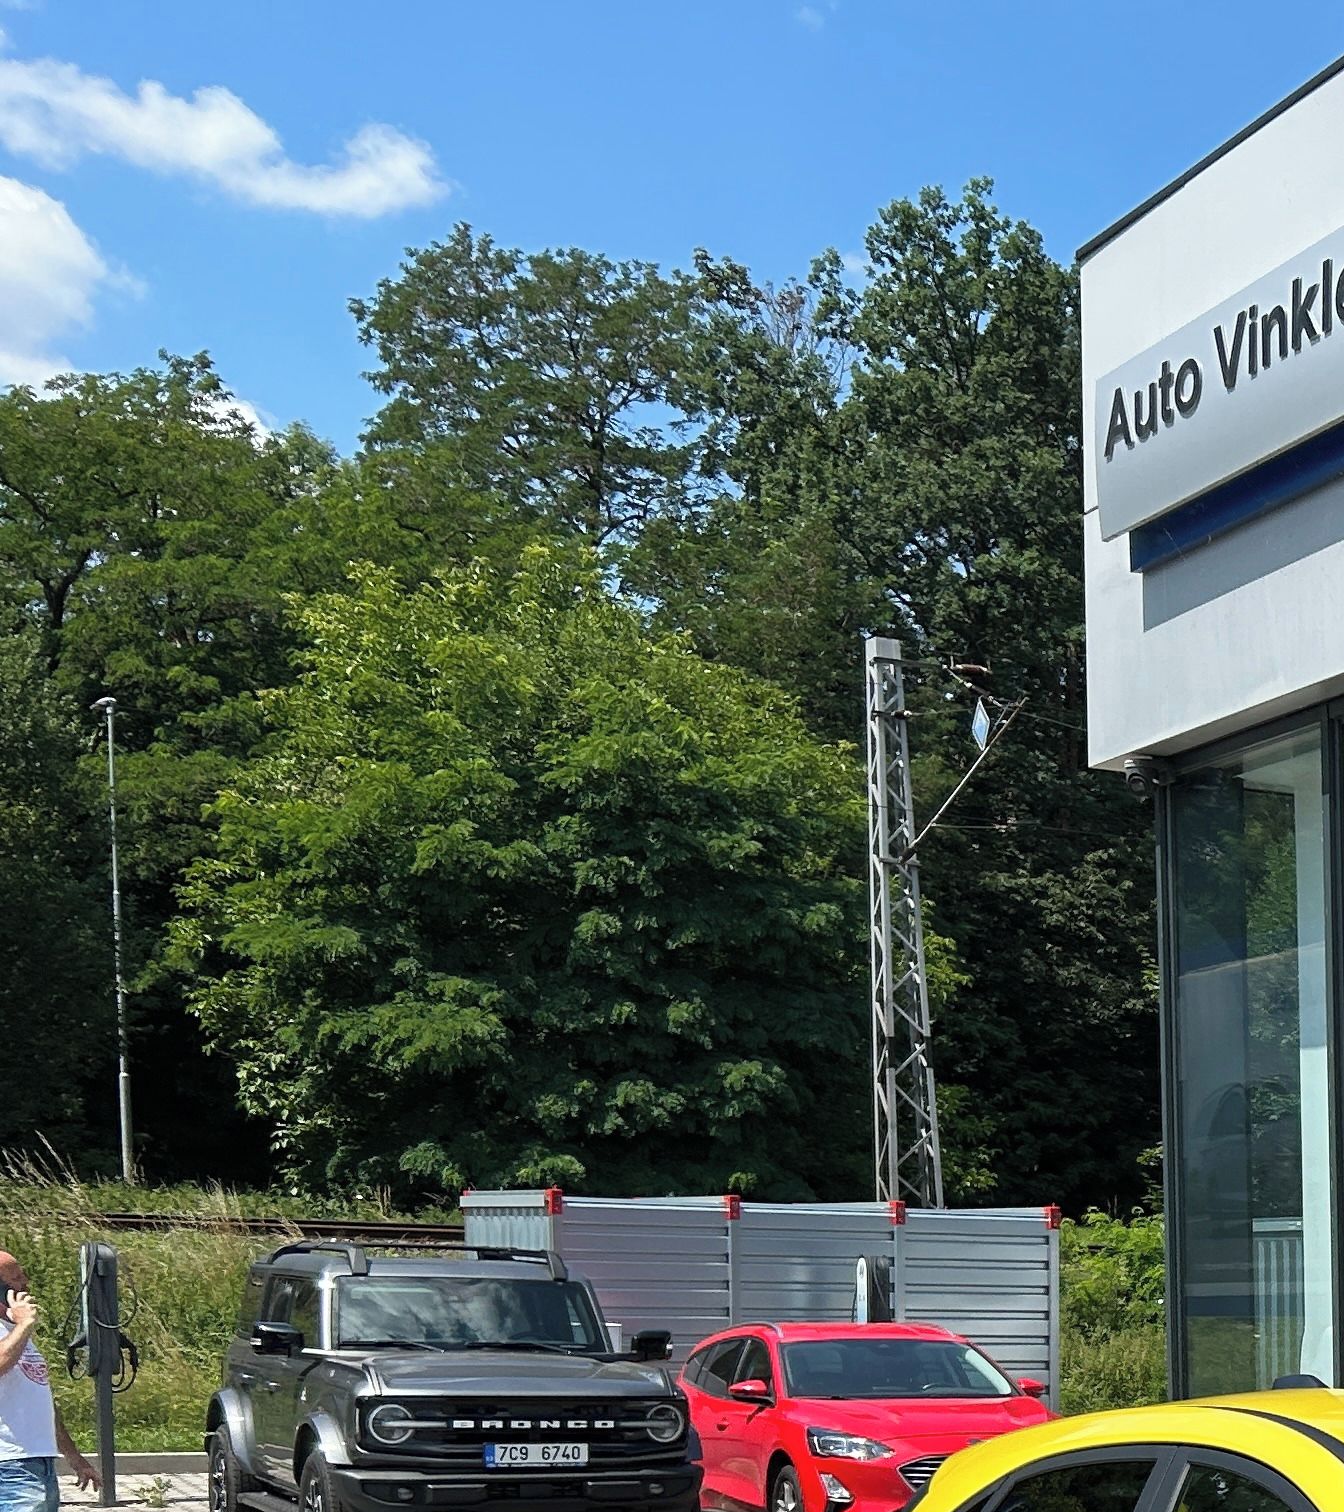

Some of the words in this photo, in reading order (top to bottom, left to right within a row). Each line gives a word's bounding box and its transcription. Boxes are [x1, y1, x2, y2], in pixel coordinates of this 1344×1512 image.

[1104, 358, 1203, 463] Auto
[453, 1420, 615, 1428] BRONCO
[498, 1446, 529, 1462] 7C9
[541, 1445, 581, 1461] 6740
